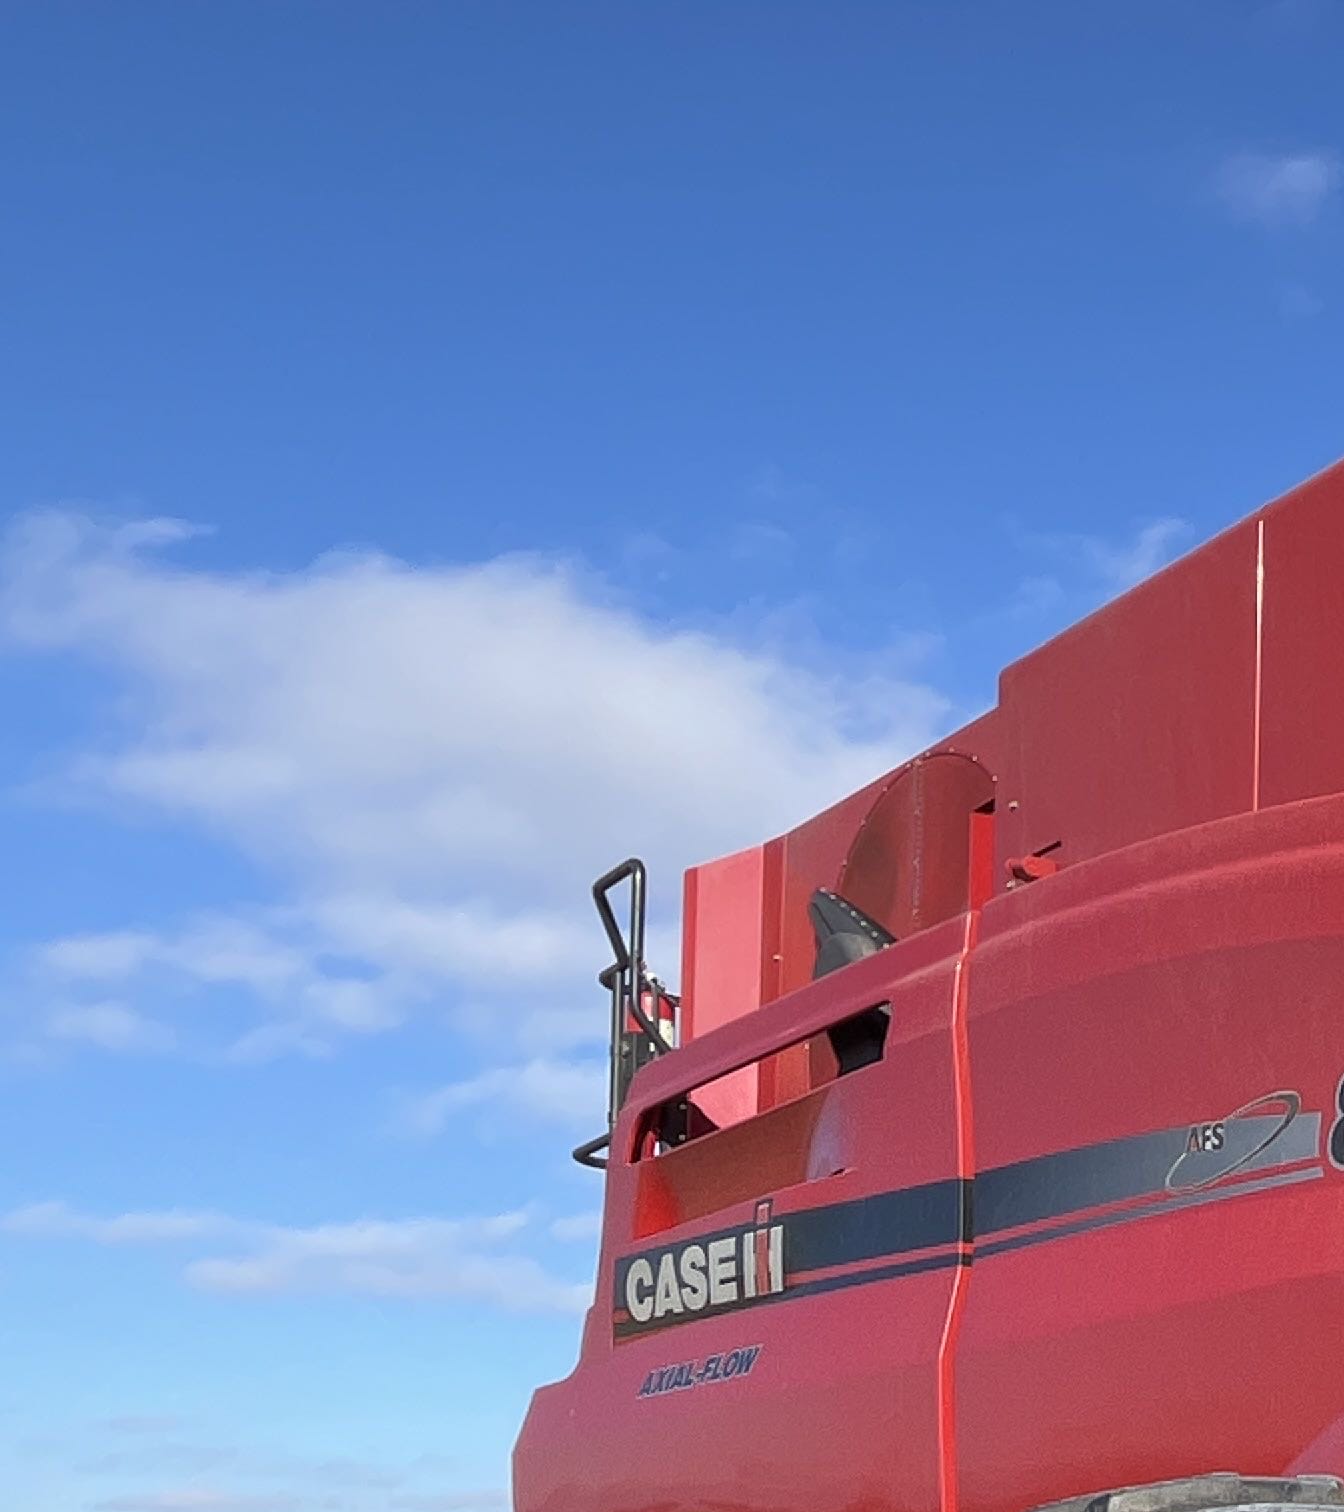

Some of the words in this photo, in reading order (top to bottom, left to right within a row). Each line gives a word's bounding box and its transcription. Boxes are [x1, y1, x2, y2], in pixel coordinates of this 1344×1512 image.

[1187, 1122, 1224, 1152] AFS
[626, 1236, 738, 1323] CASE
[636, 1344, 764, 1399] AXIAL-FLOW
